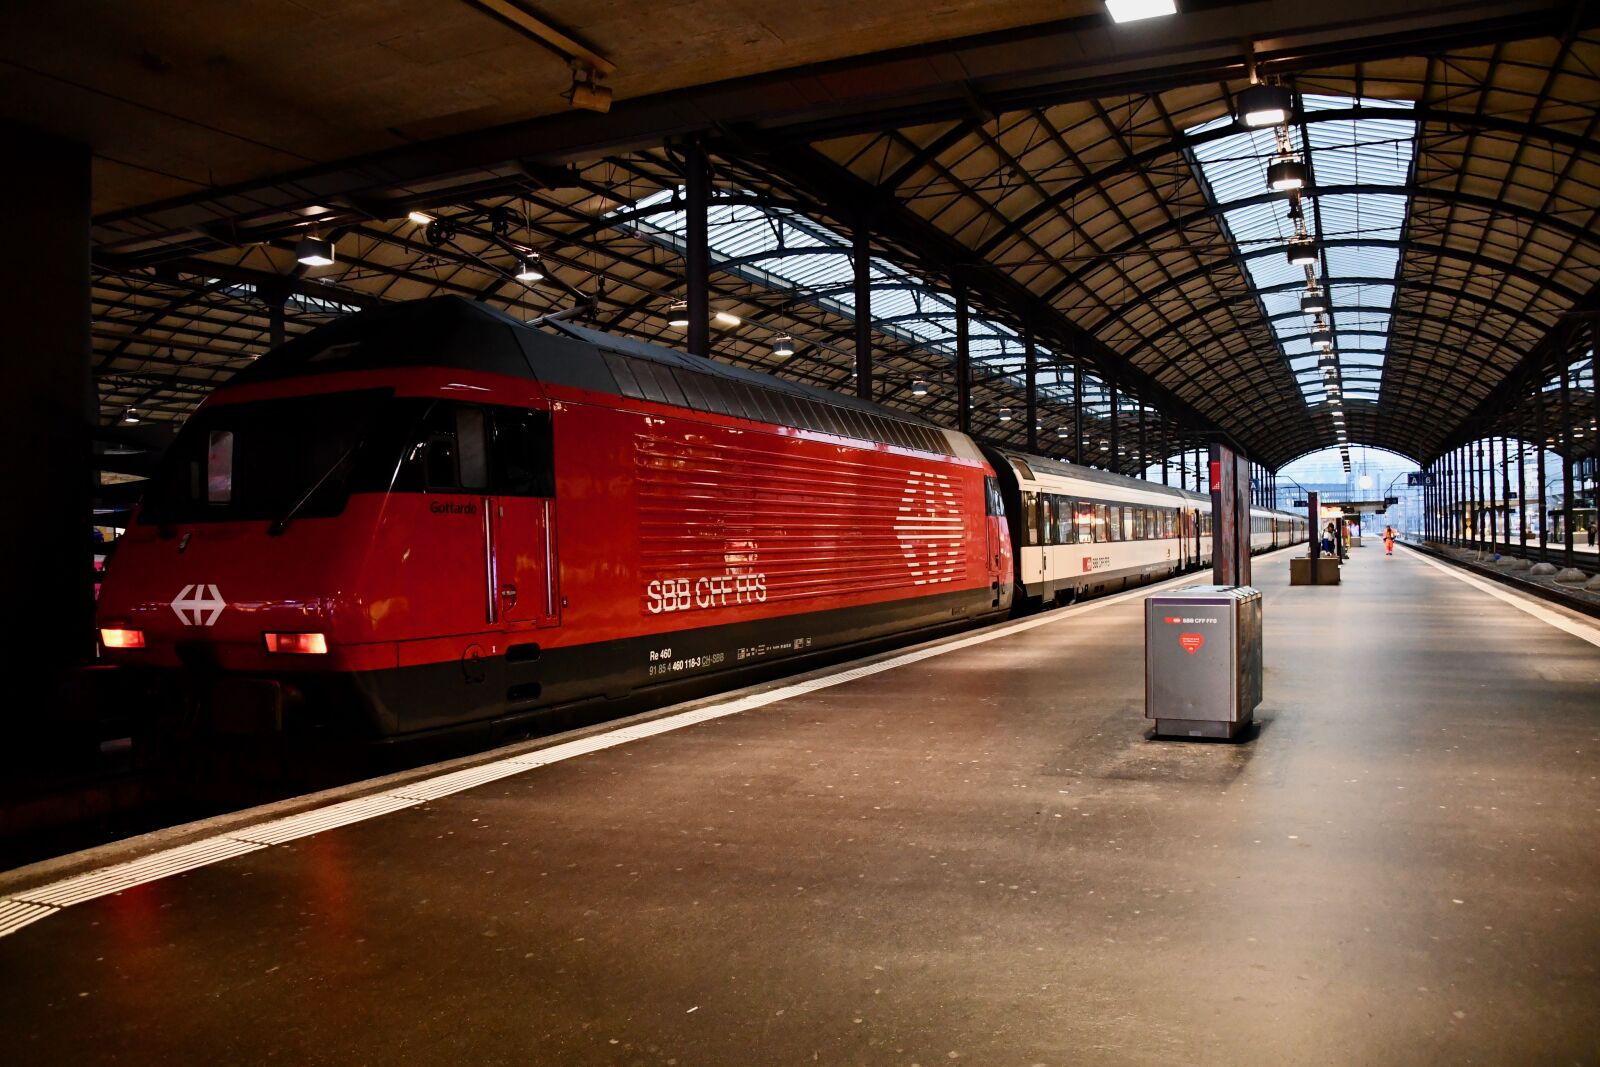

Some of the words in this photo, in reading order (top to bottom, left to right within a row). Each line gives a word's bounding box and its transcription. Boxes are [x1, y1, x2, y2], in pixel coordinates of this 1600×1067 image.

[1411, 477, 1418, 485] A
[430, 501, 477, 514] Gottardo
[648, 578, 691, 613] SBB
[696, 576, 733, 608] CFF
[737, 573, 766, 603] FFS
[649, 650, 659, 661] Re
[660, 648, 672, 659] 460
[649, 665, 657, 676] 91
[658, 663, 666, 674] 85
[667, 662, 672, 672] 4
[672, 659, 684, 671] 460
[684, 656, 701, 669] 118-3
[701, 652, 725, 667] CH-SBB
